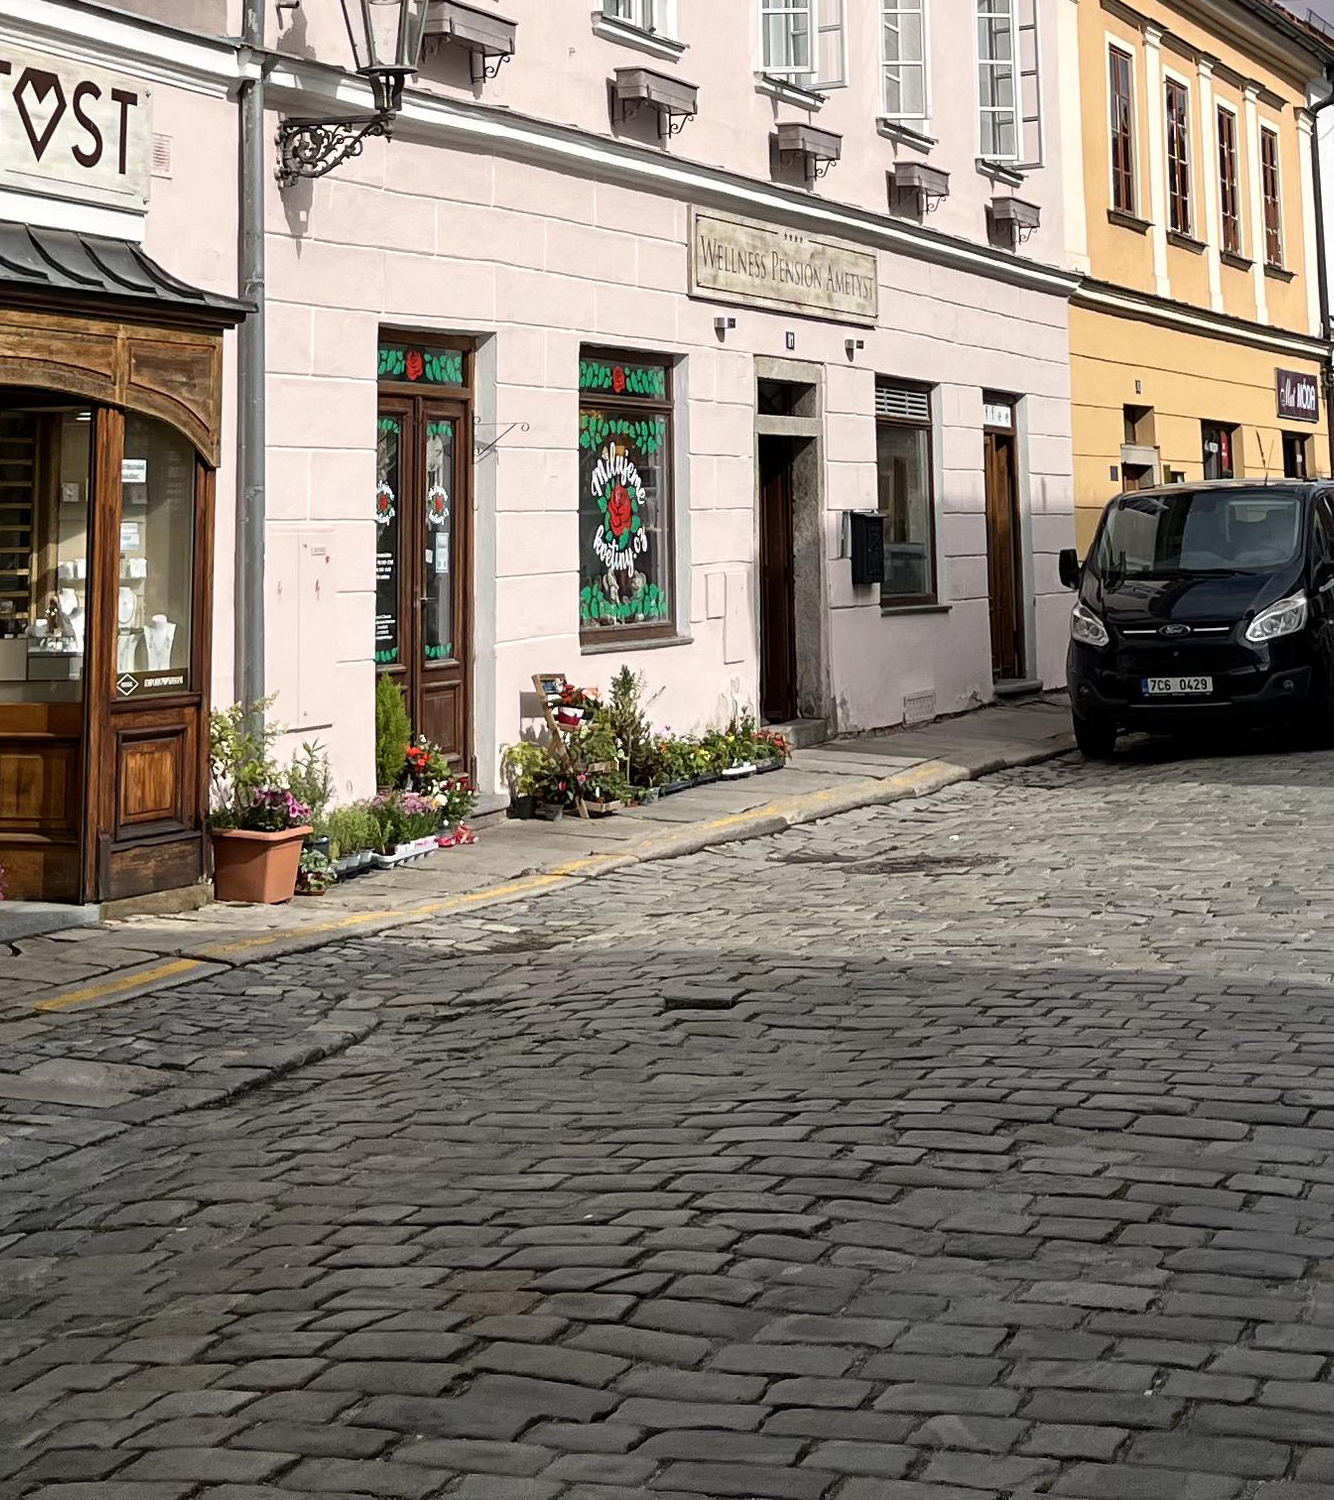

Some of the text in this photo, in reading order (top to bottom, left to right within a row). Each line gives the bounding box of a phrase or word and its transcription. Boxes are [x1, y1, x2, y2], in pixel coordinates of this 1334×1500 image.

[771, 250, 822, 289] PENSION
[1149, 678, 1208, 692] 7C6 0429
